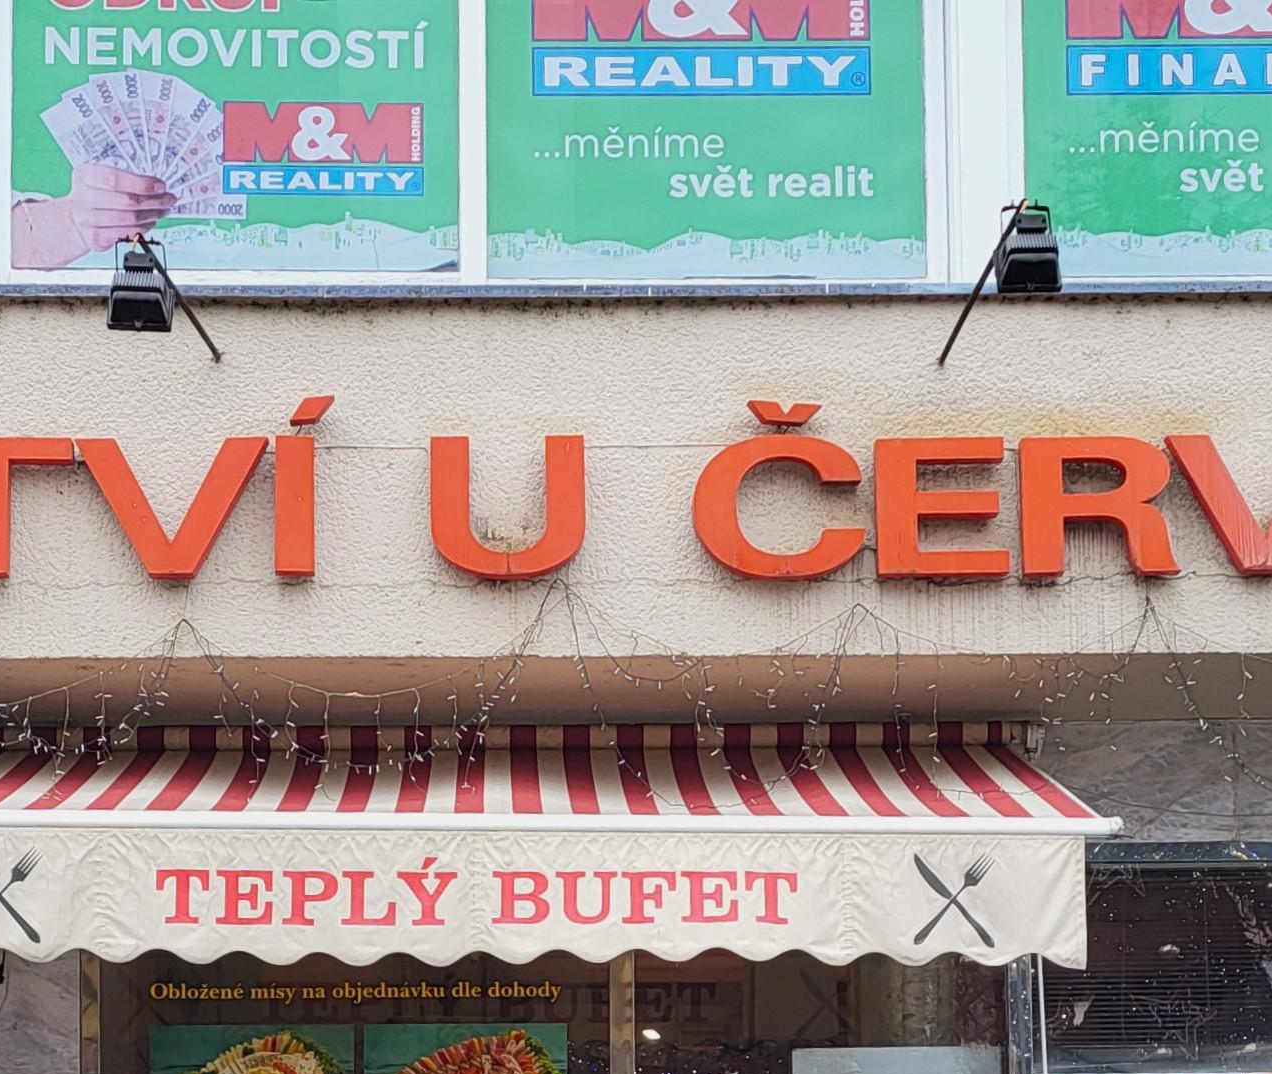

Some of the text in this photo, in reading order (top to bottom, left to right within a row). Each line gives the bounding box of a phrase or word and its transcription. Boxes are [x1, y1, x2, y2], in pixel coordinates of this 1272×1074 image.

[45, 20, 429, 69] NEMOVITOSTÍ
[543, 55, 856, 87] REALITY
[224, 102, 410, 163] M&M
[410, 106, 421, 162] HOLDING
[229, 171, 415, 190] REALITY
[669, 164, 874, 198] svět realit
[1179, 159, 1264, 192] svět
[429, 434, 585, 582] U
[154, 856, 800, 928] TEPLÝ BUFET
[149, 982, 244, 1000] Obložené
[249, 981, 295, 1004] mísy
[302, 985, 326, 999] na
[332, 981, 446, 1004] objednávku
[452, 981, 482, 999] dle
[487, 981, 562, 1003] dohody
